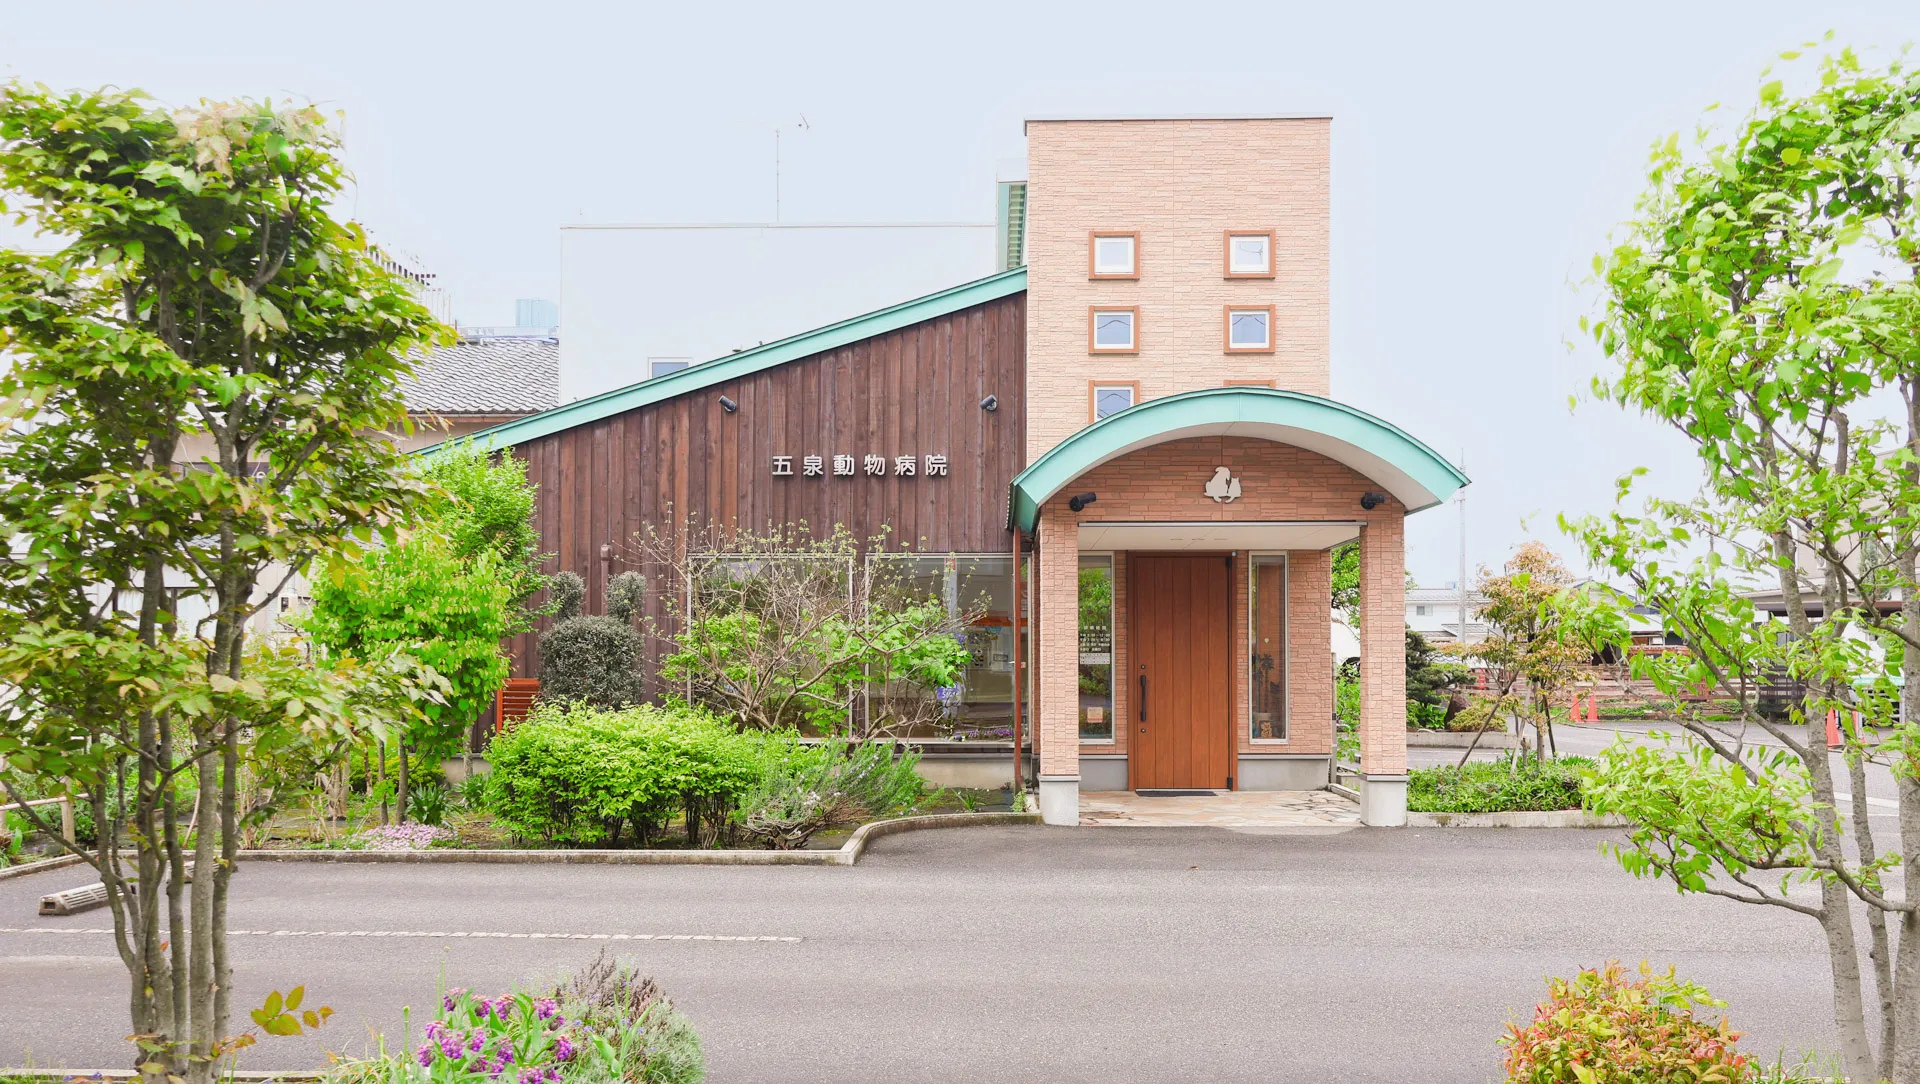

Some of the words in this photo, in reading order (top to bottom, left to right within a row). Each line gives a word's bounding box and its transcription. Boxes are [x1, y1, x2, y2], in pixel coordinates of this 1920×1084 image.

[772, 454, 948, 476] 五泉動物病院
